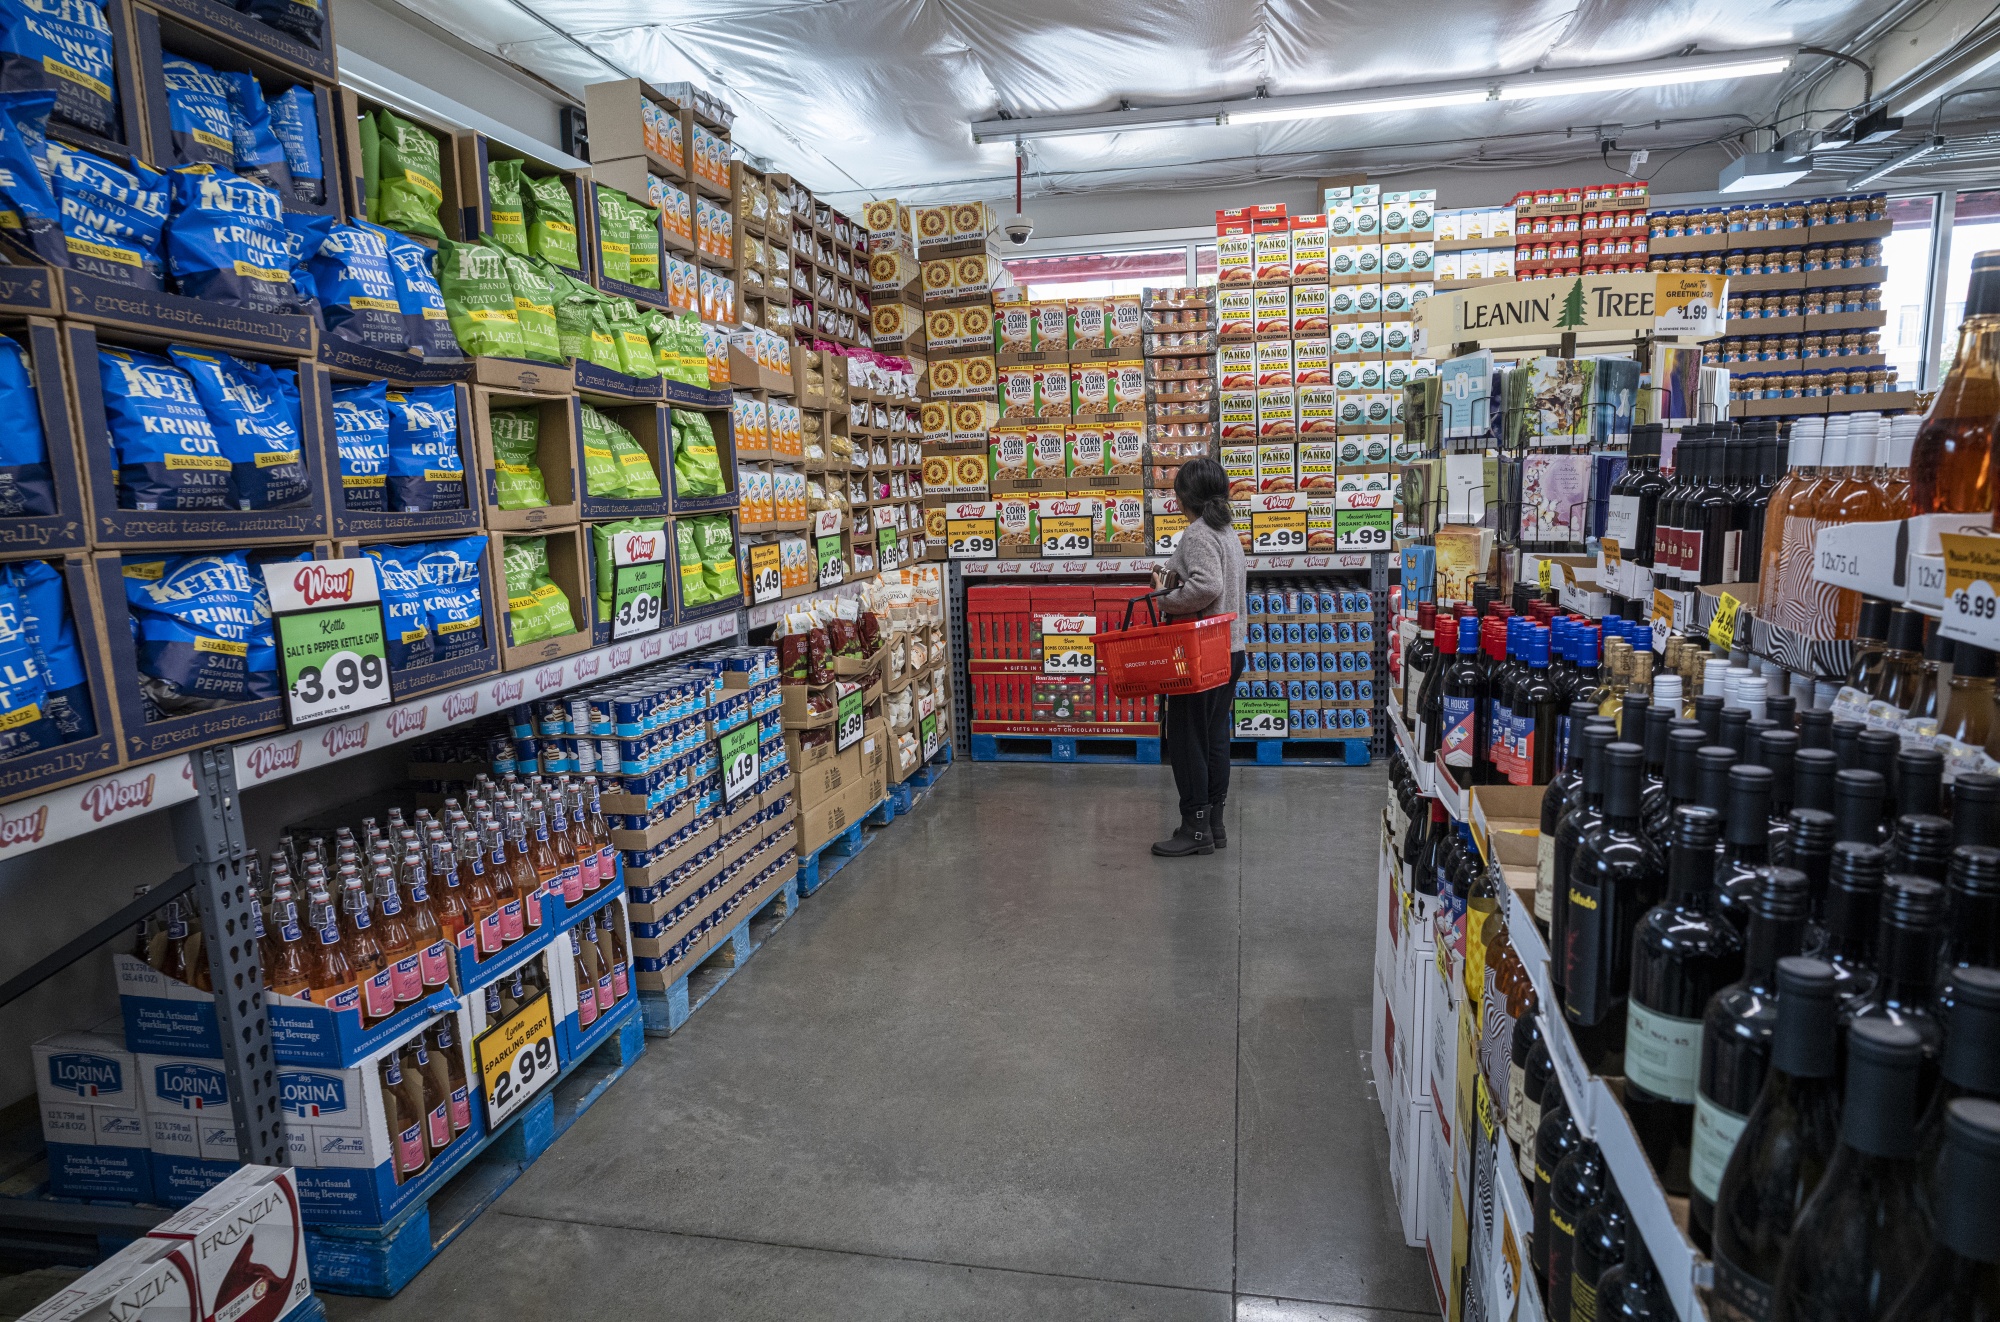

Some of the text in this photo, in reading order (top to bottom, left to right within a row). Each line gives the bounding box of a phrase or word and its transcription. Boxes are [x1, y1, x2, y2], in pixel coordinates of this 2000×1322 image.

[45, 20, 96, 40] BRAND
[61, 49, 101, 78] CUT
[1519, 206, 1531, 214] Jif
[1585, 201, 1597, 209] Jif
[1220, 242, 1248, 253] PANKO
[1296, 236, 1324, 246] PANKO
[66, 240, 136, 263] SHARING SIZE
[350, 256, 379, 267] BRAND
[363, 283, 389, 298] CUT
[94, 294, 151, 316] great
[356, 300, 385, 308] SHARING
[460, 294, 497, 304] POTATO
[1222, 297, 1249, 307] PANKO
[1464, 287, 1654, 330] LEANIN' TREE
[1677, 304, 1708, 320] $1.99
[1262, 395, 1290, 406] PANKO
[1303, 393, 1332, 404] PANKO
[180, 437, 220, 454] CUT
[1040, 438, 1060, 447] CORN
[1041, 445, 1061, 453] FLAKES
[171, 458, 213, 467] SHARING
[1262, 453, 1290, 463] PANKO
[183, 472, 227, 486] SALT &
[490, 478, 541, 496] ALAPEÑO
[176, 495, 226, 508] PEPPER
[1051, 501, 1081, 515] Wow!
[1263, 495, 1295, 511] Wow!
[1348, 493, 1381, 508] Wow!
[957, 504, 985, 518] Wow!
[1005, 506, 1026, 514] CORN
[1044, 535, 1089, 550] $3.49
[1255, 531, 1304, 546] $2.99
[1340, 529, 1387, 545] $1.99
[626, 535, 656, 562] Wow!
[950, 538, 993, 552] $2.99
[965, 561, 989, 573] Wow!
[1268, 555, 1294, 568] Wow!
[1821, 551, 1860, 576] 12x75 cl.
[294, 565, 354, 605] Wow!
[616, 596, 659, 626] $3.99
[1955, 593, 1996, 620] $6.99
[319, 618, 345, 634] Kettle
[1054, 618, 1085, 633] Wow!
[286, 632, 379, 658] SALT & PEPPER KETTLE CHIP
[207, 655, 236, 671] SALT
[1046, 654, 1092, 667] $5.48
[1125, 660, 1148, 669] GROCERY
[195, 678, 244, 693] PEPPER
[290, 654, 383, 703] $3.99
[1451, 700, 1469, 710] HOUSE
[1236, 717, 1285, 731] $2.49
[746, 738, 757, 751] MILK
[247, 740, 303, 779] Wow!
[726, 754, 753, 788] $1.19
[80, 772, 156, 822] Wow!
[139, 1009, 198, 1021] French Artisanal
[137, 1019, 205, 1033] Sparkling Beverage
[505, 1020, 525, 1041] Lorina
[485, 1016, 548, 1074] SPARKLING BERRY
[57, 1061, 116, 1083] LORINA
[490, 1037, 552, 1109] $2.99
[163, 1071, 222, 1095] LORINA
[201, 1191, 283, 1260] FRANZIA
[294, 1278, 307, 1294] 20
[217, 1293, 250, 1321] CALIFORNIA
[229, 1307, 241, 1319] RED
